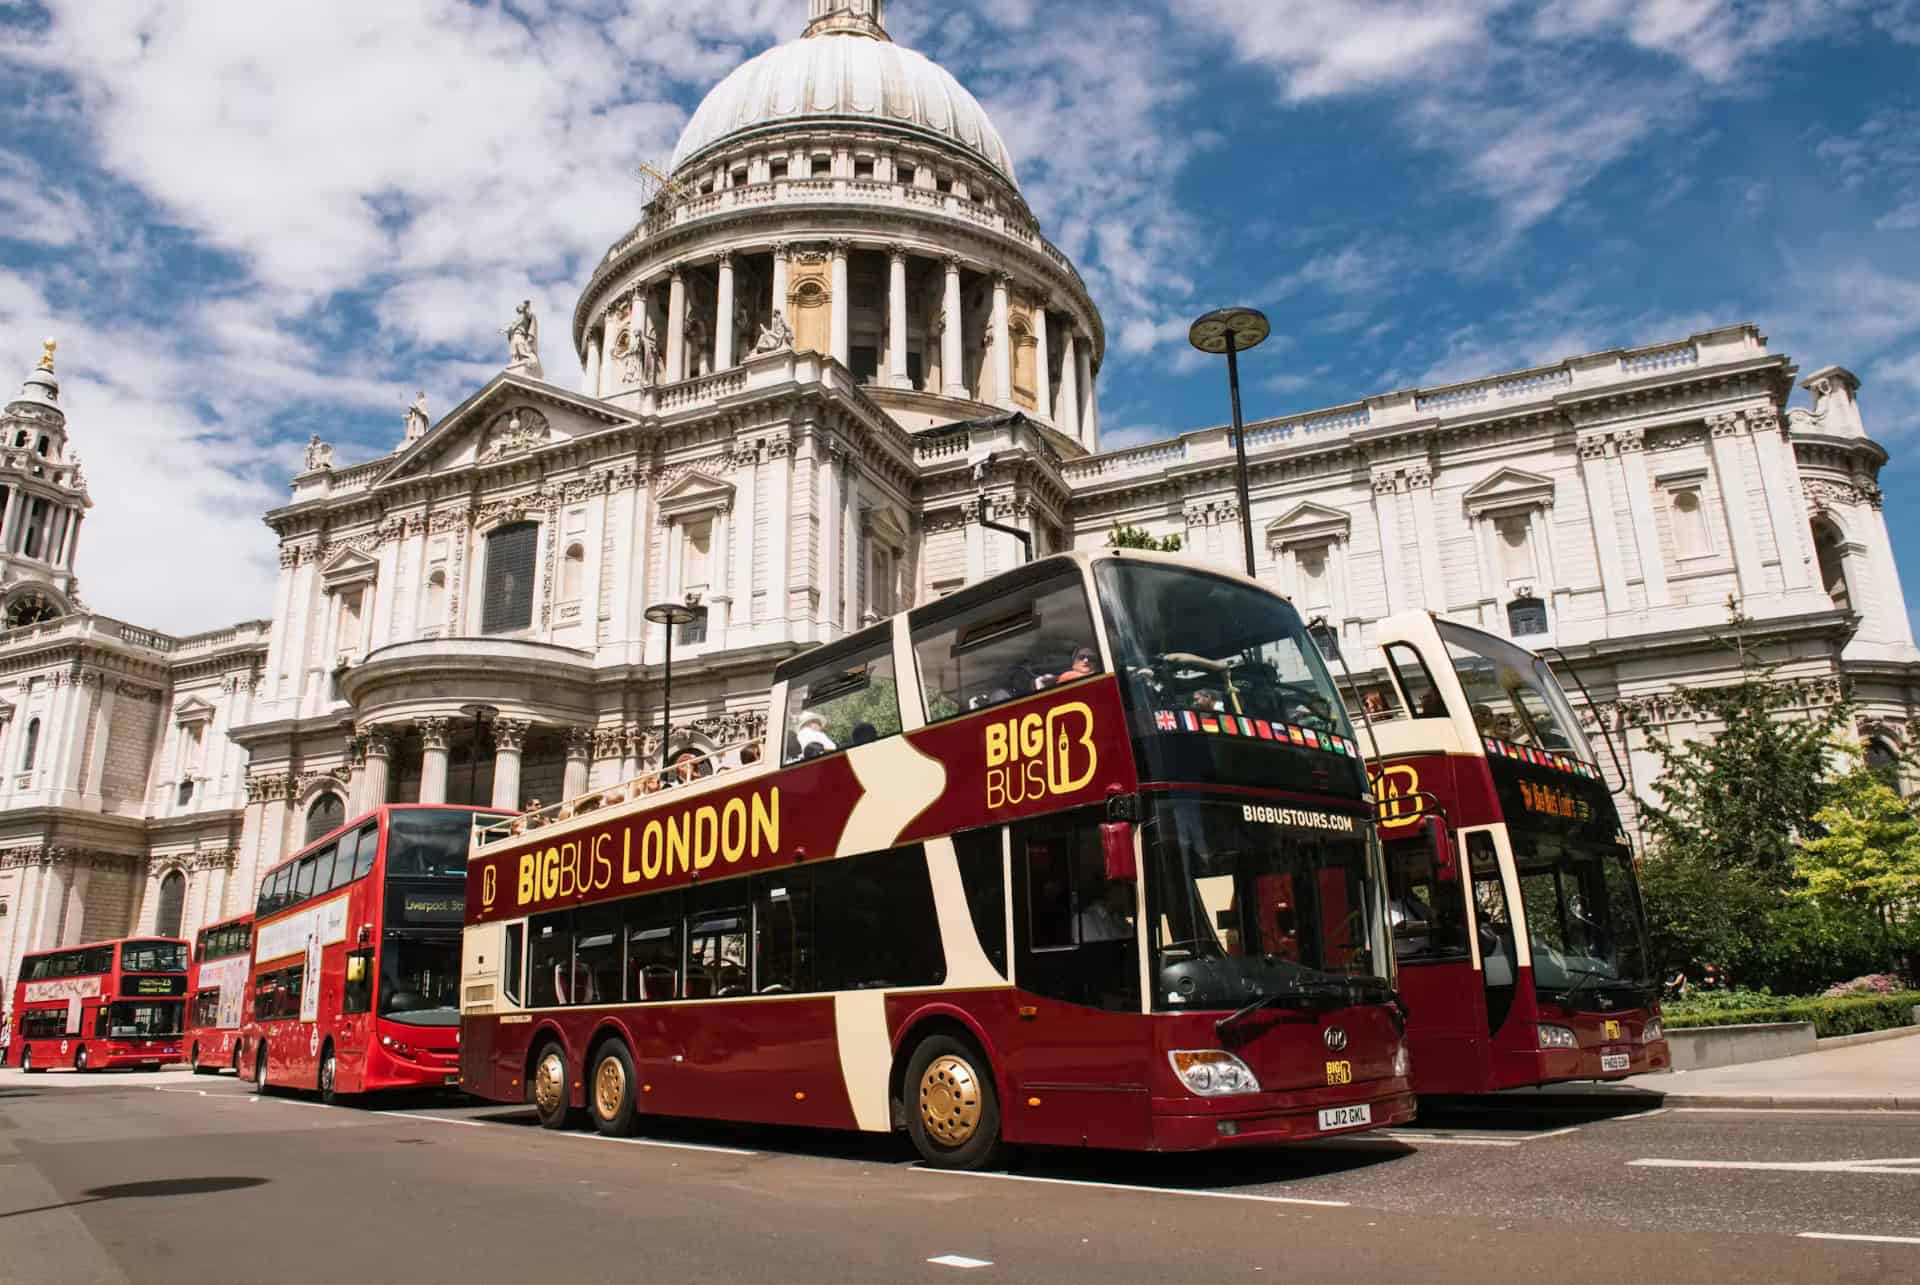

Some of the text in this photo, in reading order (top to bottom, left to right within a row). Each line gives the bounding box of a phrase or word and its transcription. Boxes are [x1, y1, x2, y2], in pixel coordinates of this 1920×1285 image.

[985, 712, 1044, 768] BIG
[987, 759, 1046, 809] BUS
[622, 786, 780, 884] LONDON
[1242, 804, 1354, 832] BIGBUSTOURS.COM
[1349, 1107, 1366, 1122] GKL
